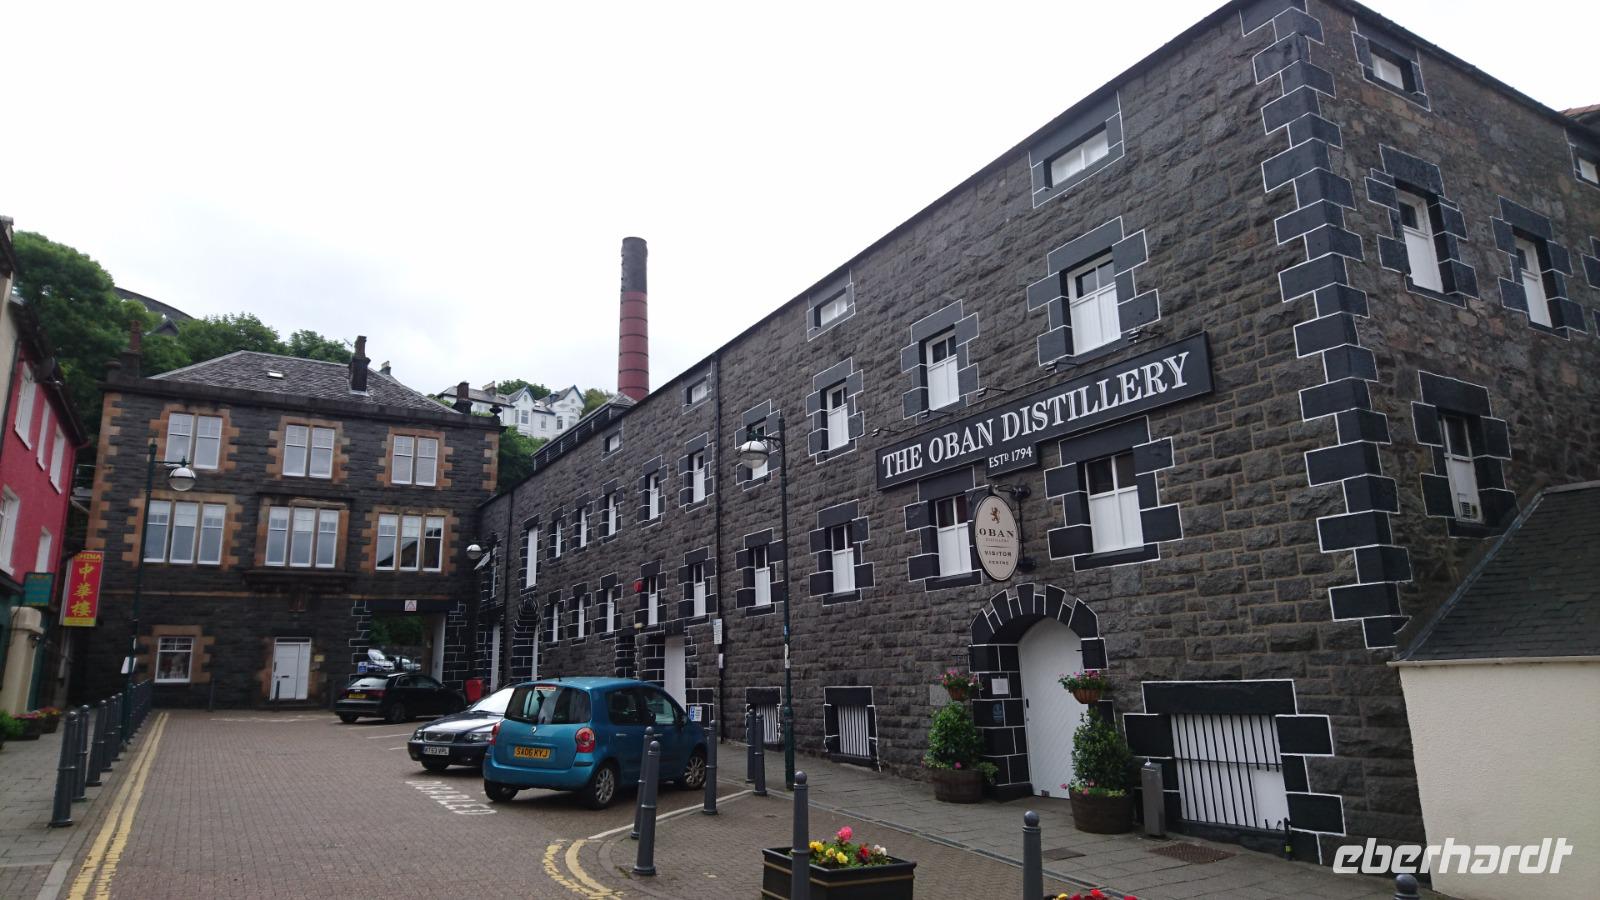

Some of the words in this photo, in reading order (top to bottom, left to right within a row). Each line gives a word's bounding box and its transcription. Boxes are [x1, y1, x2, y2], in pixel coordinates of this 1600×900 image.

[882, 443, 923, 479] THE
[928, 418, 993, 464] OBAN
[1001, 350, 1190, 442] DISTILLERY
[1011, 445, 1033, 462] 1794
[979, 527, 1014, 538] OBAN
[71, 563, 95, 616] 中華樓
[534, 748, 548, 758] KYJ
[404, 780, 497, 815] DISABLED
